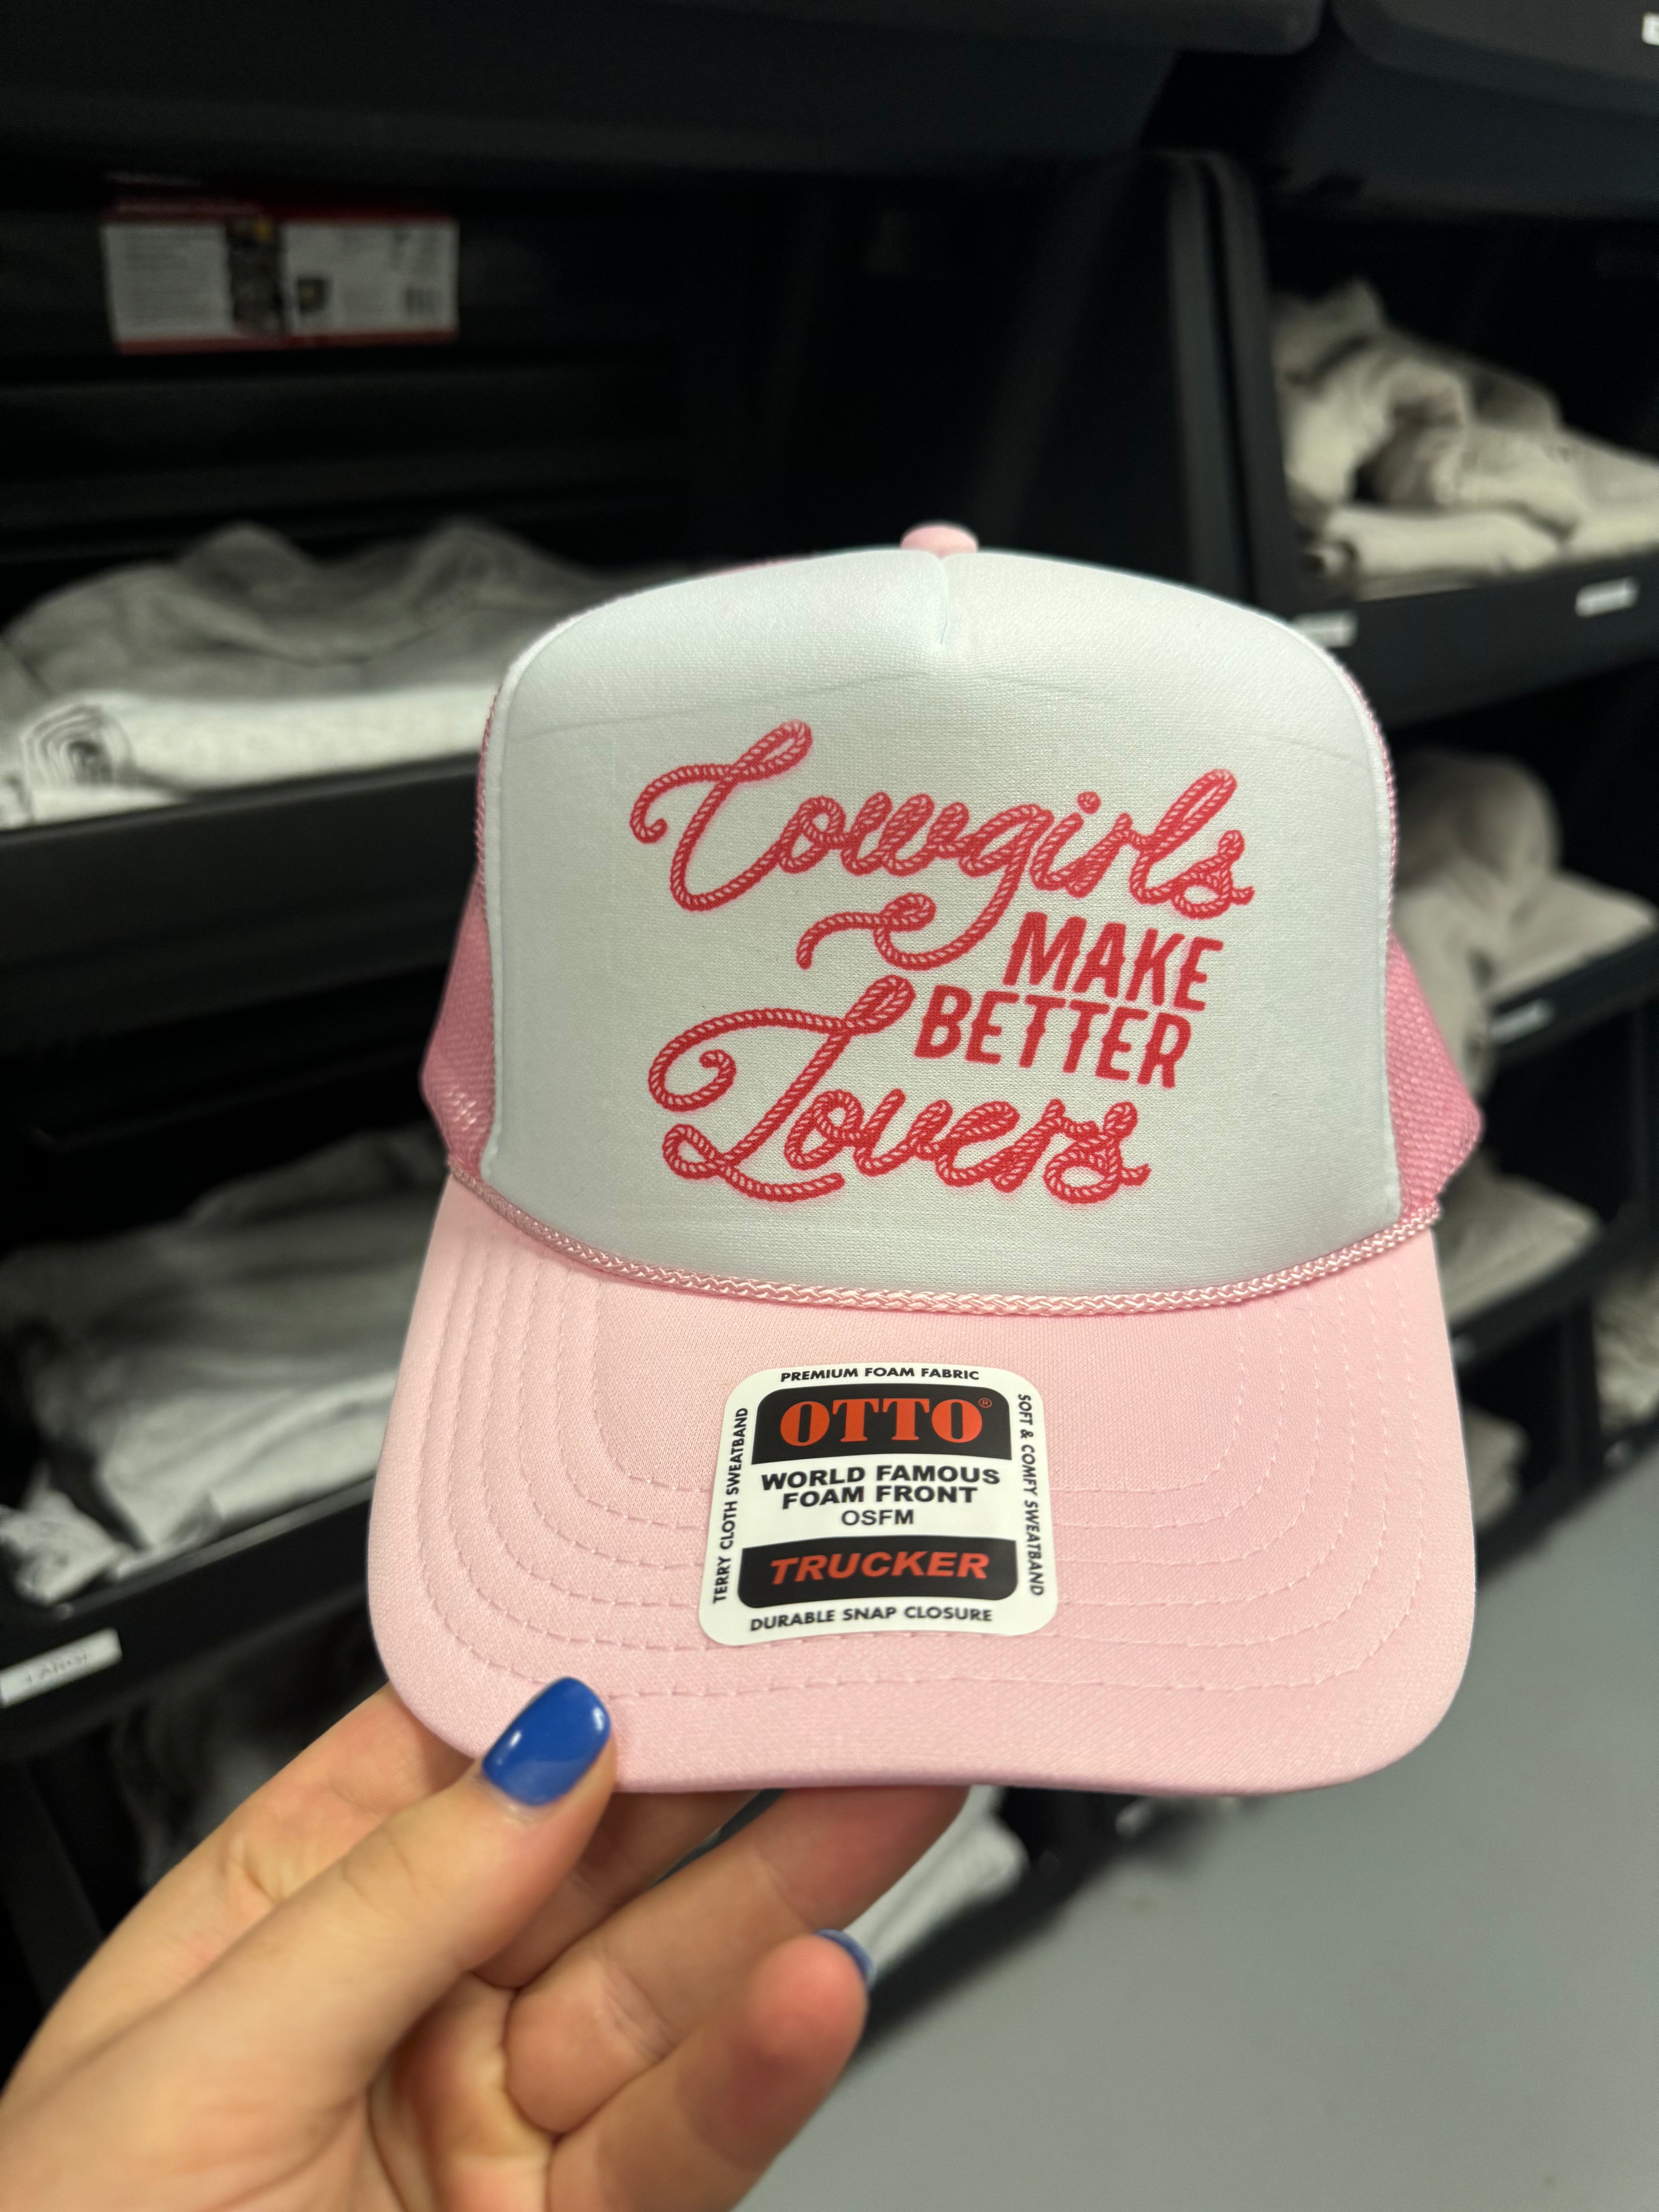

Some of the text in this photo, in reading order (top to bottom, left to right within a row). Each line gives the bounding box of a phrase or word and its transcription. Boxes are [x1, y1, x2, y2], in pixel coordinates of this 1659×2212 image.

[630, 719, 1254, 969] Cowgirls
[1001, 911, 1224, 1012] MAKE
[914, 984, 1192, 1089] BETTER
[648, 974, 1151, 1205] Lovers
[781, 1367, 979, 1382] PREMIUM FOAM FABRIC
[713, 1408, 748, 1604] TERRY CLOTH SWEATBAND
[761, 1465, 1000, 1491] WORLD FAMOUS
[782, 1486, 978, 1509] FOAM FRONT
[1018, 1394, 1044, 1596] SOFT & COMFY SWEATBAND
[841, 1510, 914, 1526] OSFM
[770, 1551, 989, 1585] TRUCKER
[750, 1606, 992, 1632] DURABLE SNAP CLOSURE
